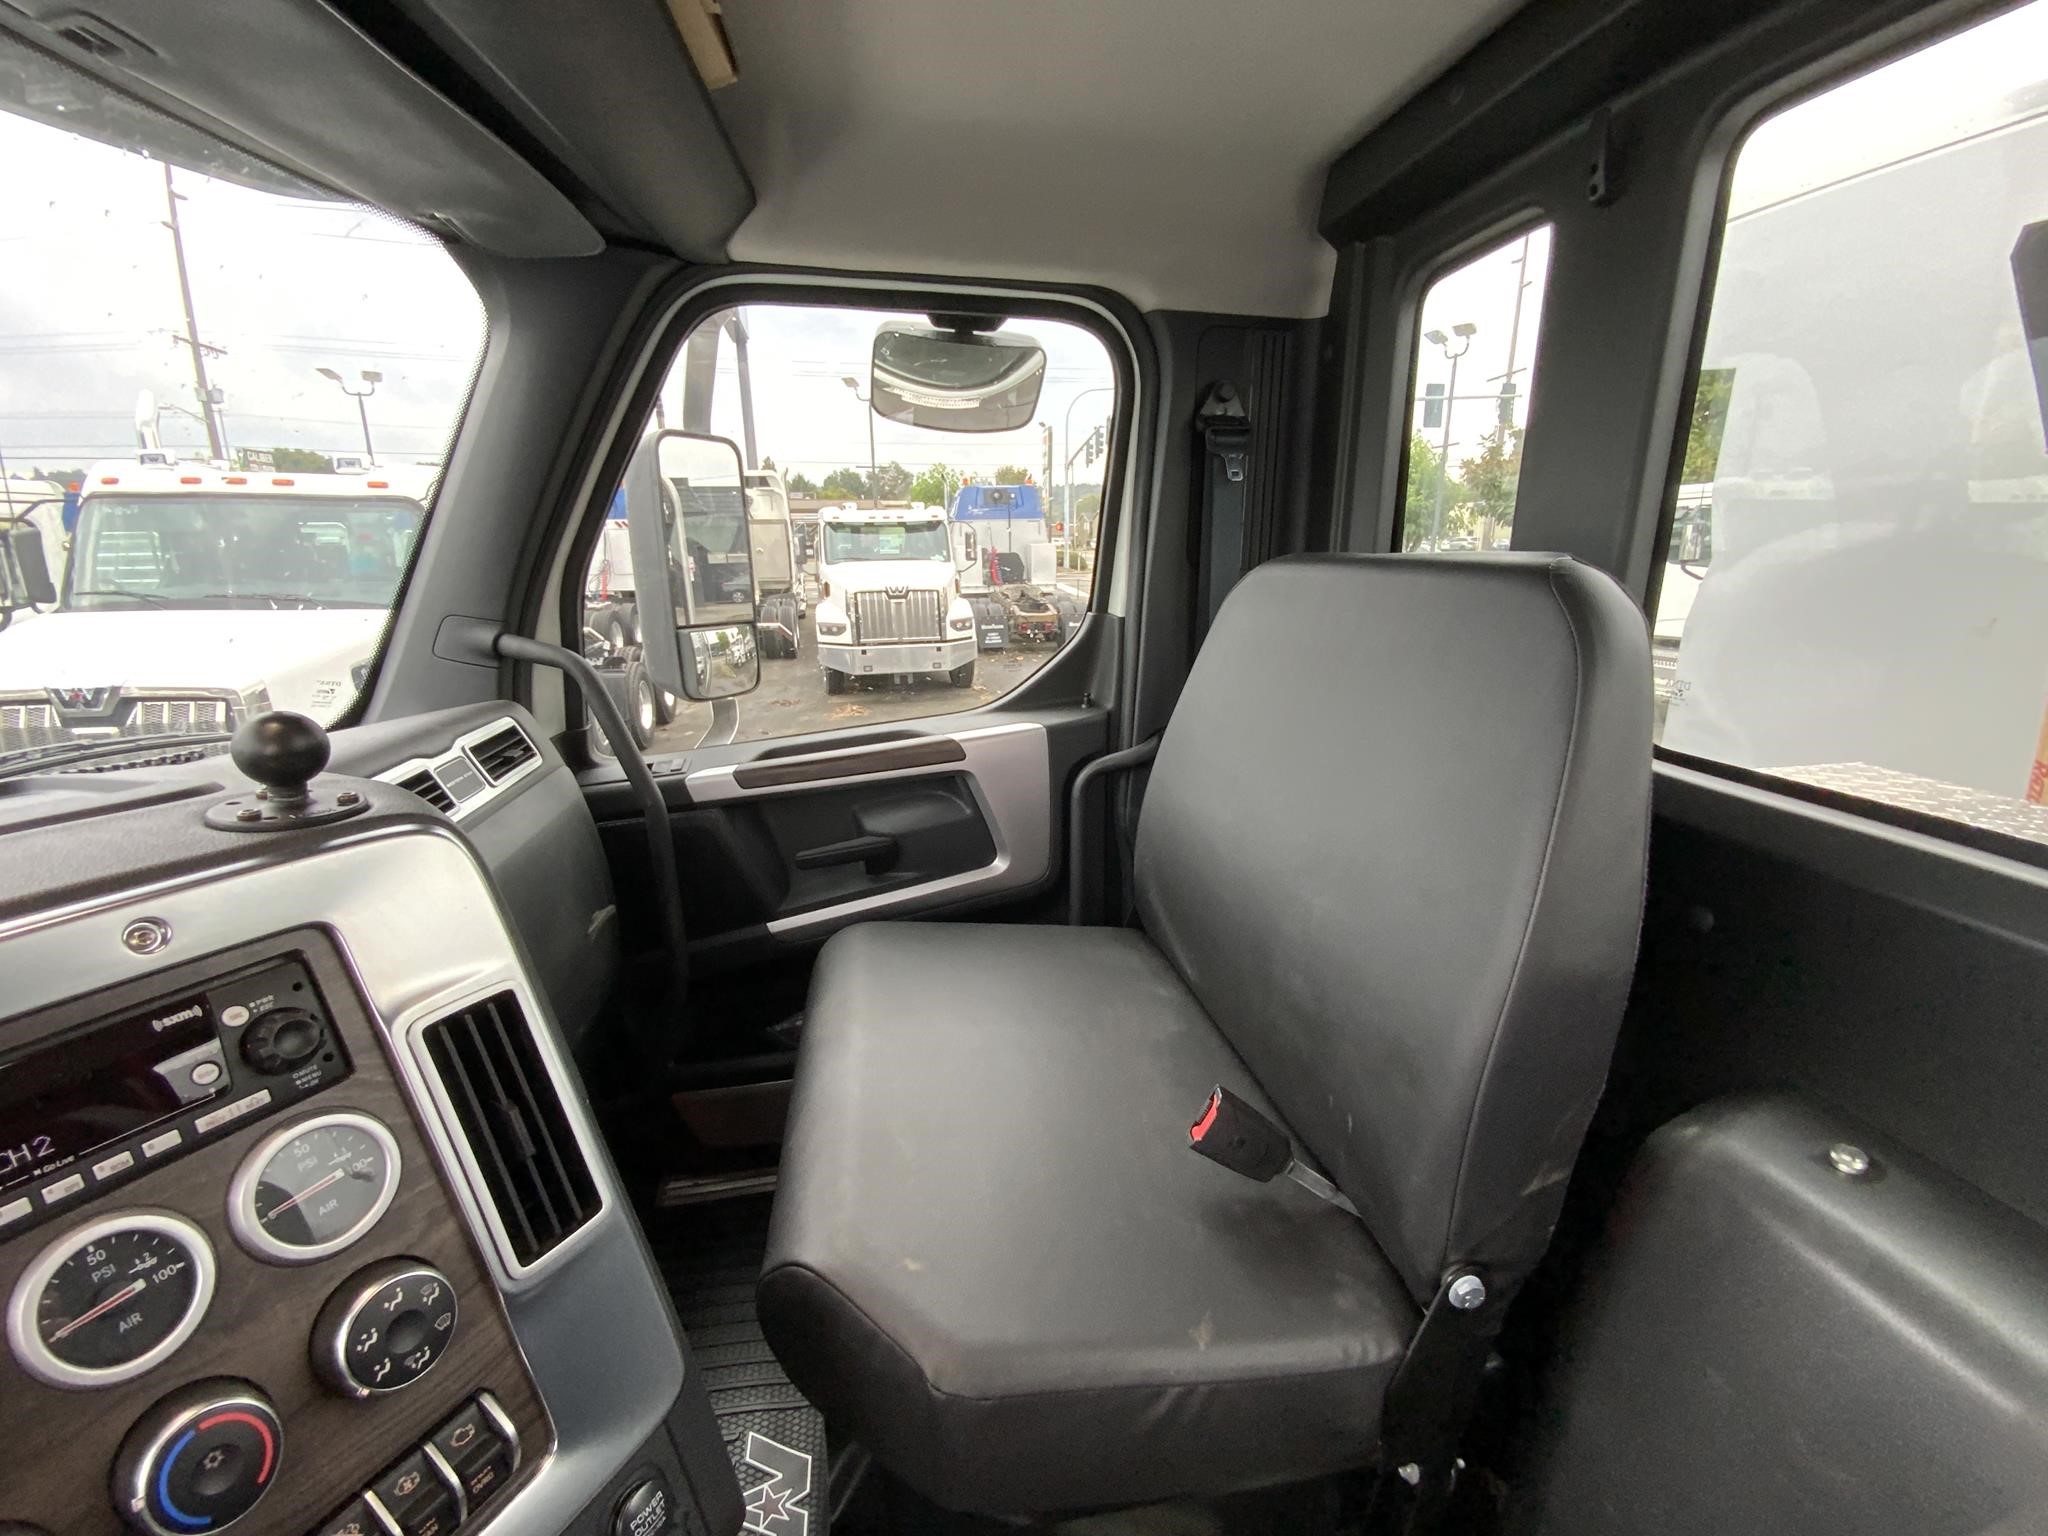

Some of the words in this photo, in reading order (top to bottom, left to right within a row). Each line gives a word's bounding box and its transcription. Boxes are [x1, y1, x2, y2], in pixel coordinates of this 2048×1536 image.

[293, 1143, 311, 1158] 50
[297, 1156, 318, 1173] PSI
[318, 1198, 340, 1217] AIR
[86, 1248, 107, 1267] 50
[91, 1262, 117, 1283] PSI
[152, 1263, 178, 1285] 100
[118, 1311, 143, 1334] AIR
[629, 1489, 664, 1531] POWER
[634, 1498, 666, 1536] OUTLET
